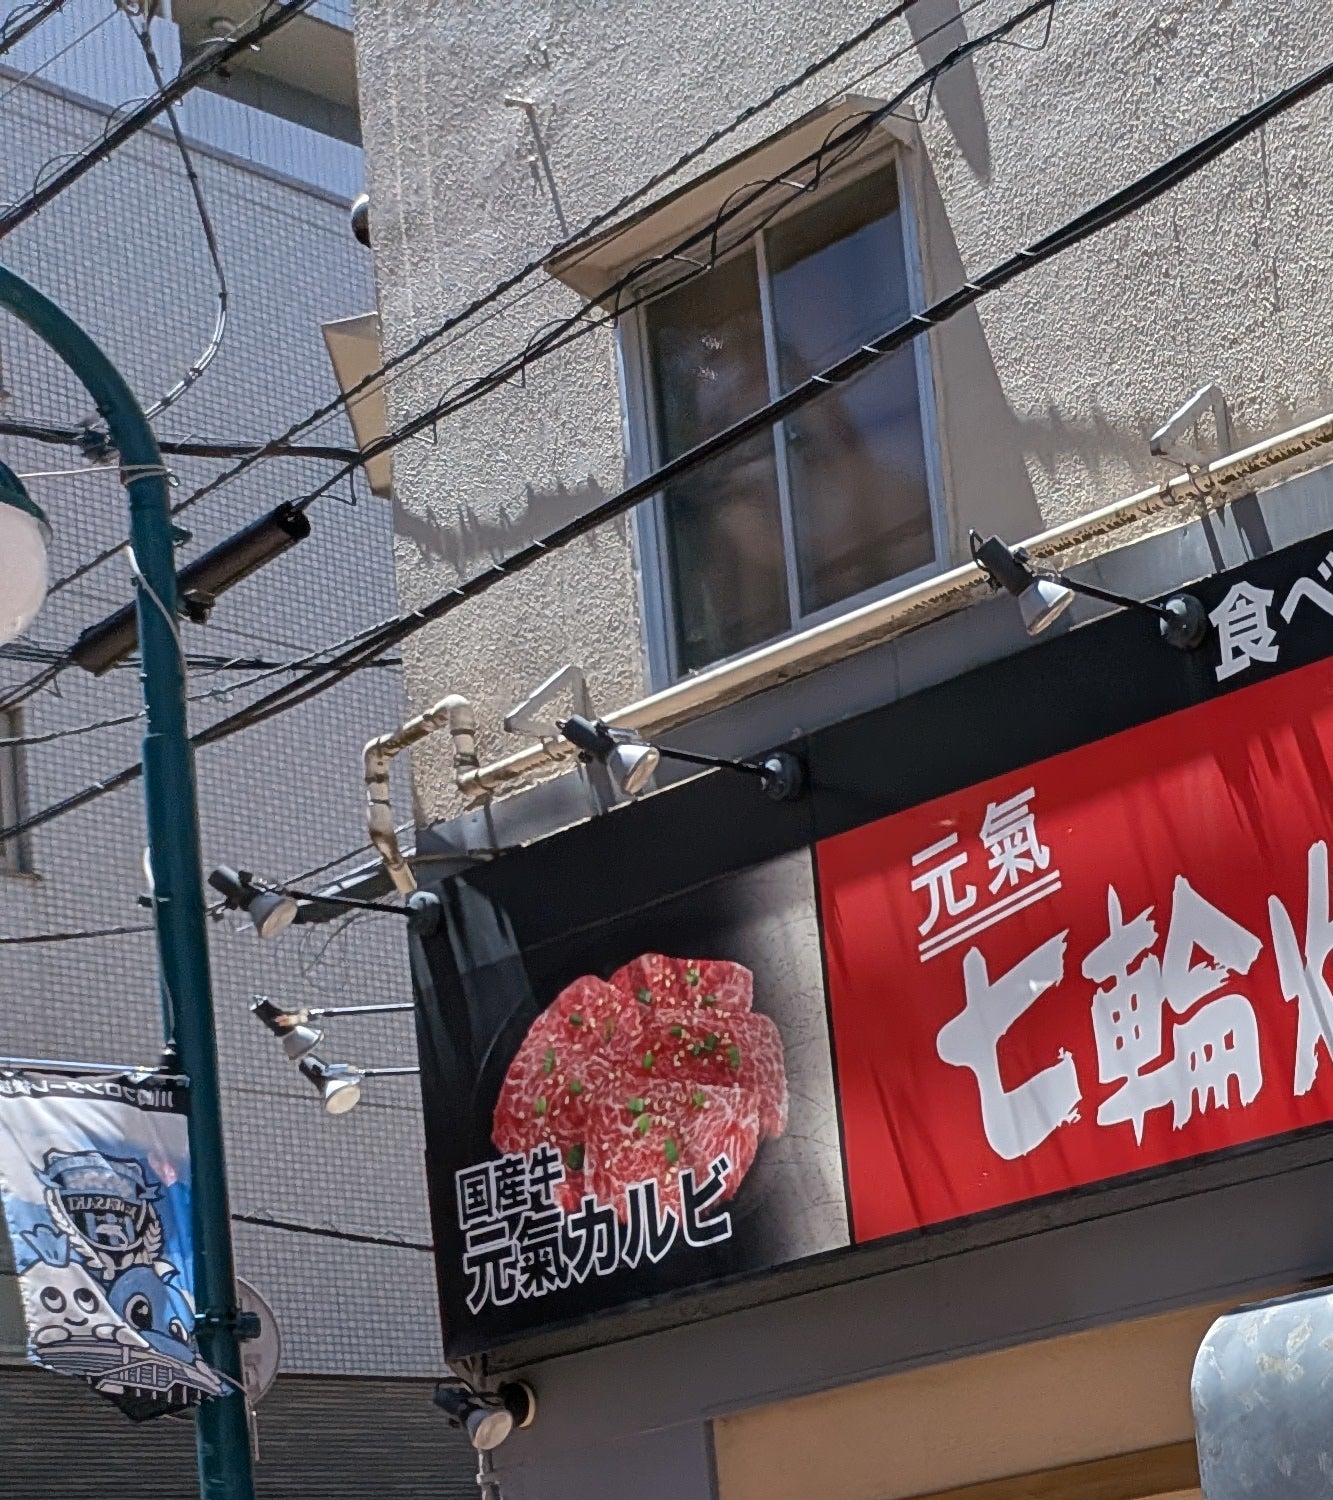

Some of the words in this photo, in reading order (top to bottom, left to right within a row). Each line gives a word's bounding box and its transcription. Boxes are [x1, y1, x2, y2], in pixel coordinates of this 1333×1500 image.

[910, 787, 1052, 937] 元氣
[454, 1143, 566, 1229] 国産牛
[462, 1152, 733, 1315] 元氣カルビ
